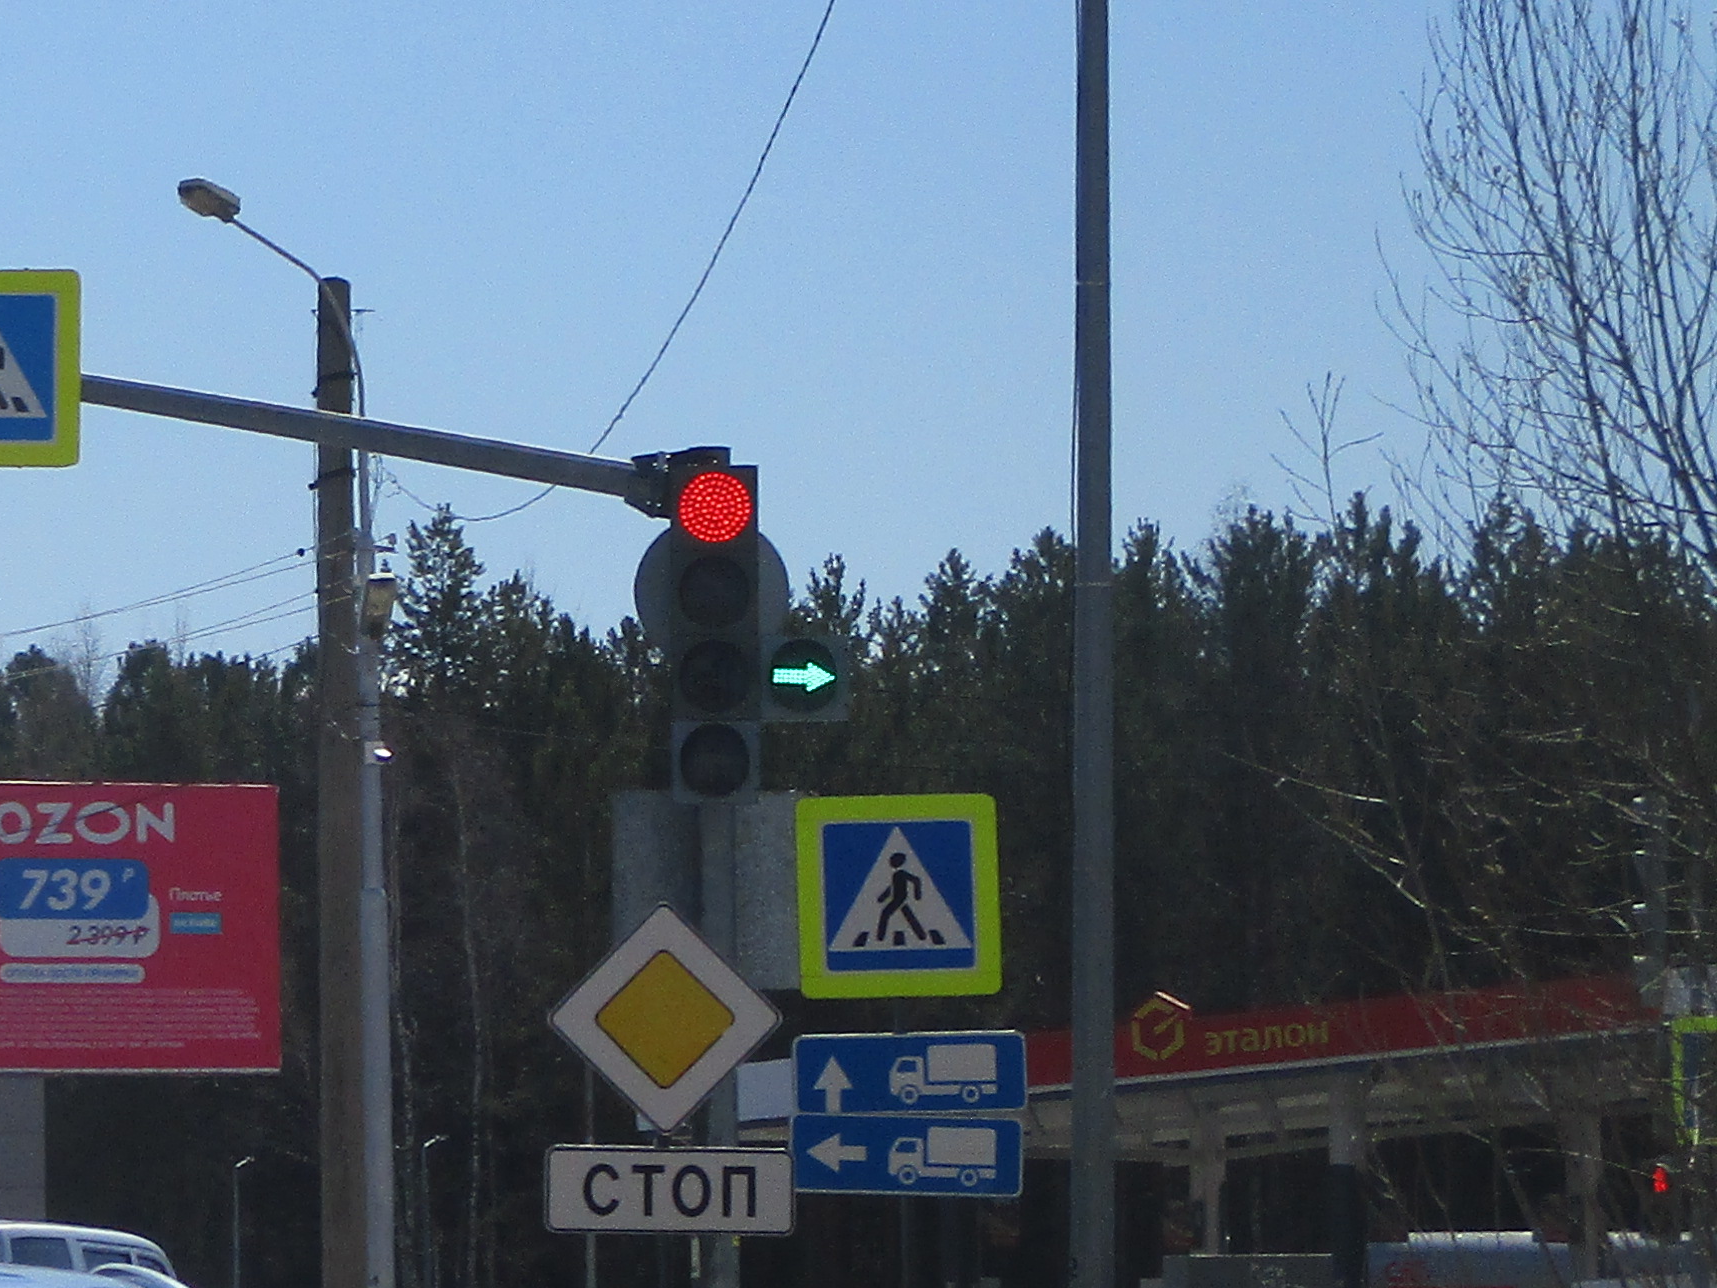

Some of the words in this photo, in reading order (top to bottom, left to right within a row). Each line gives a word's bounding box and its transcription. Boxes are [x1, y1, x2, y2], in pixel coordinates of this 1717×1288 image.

[19, 868, 112, 911] 739
[168, 887, 223, 902] Платье
[1203, 1017, 1330, 1058] эталон
[582, 1162, 758, 1219] СТОП
